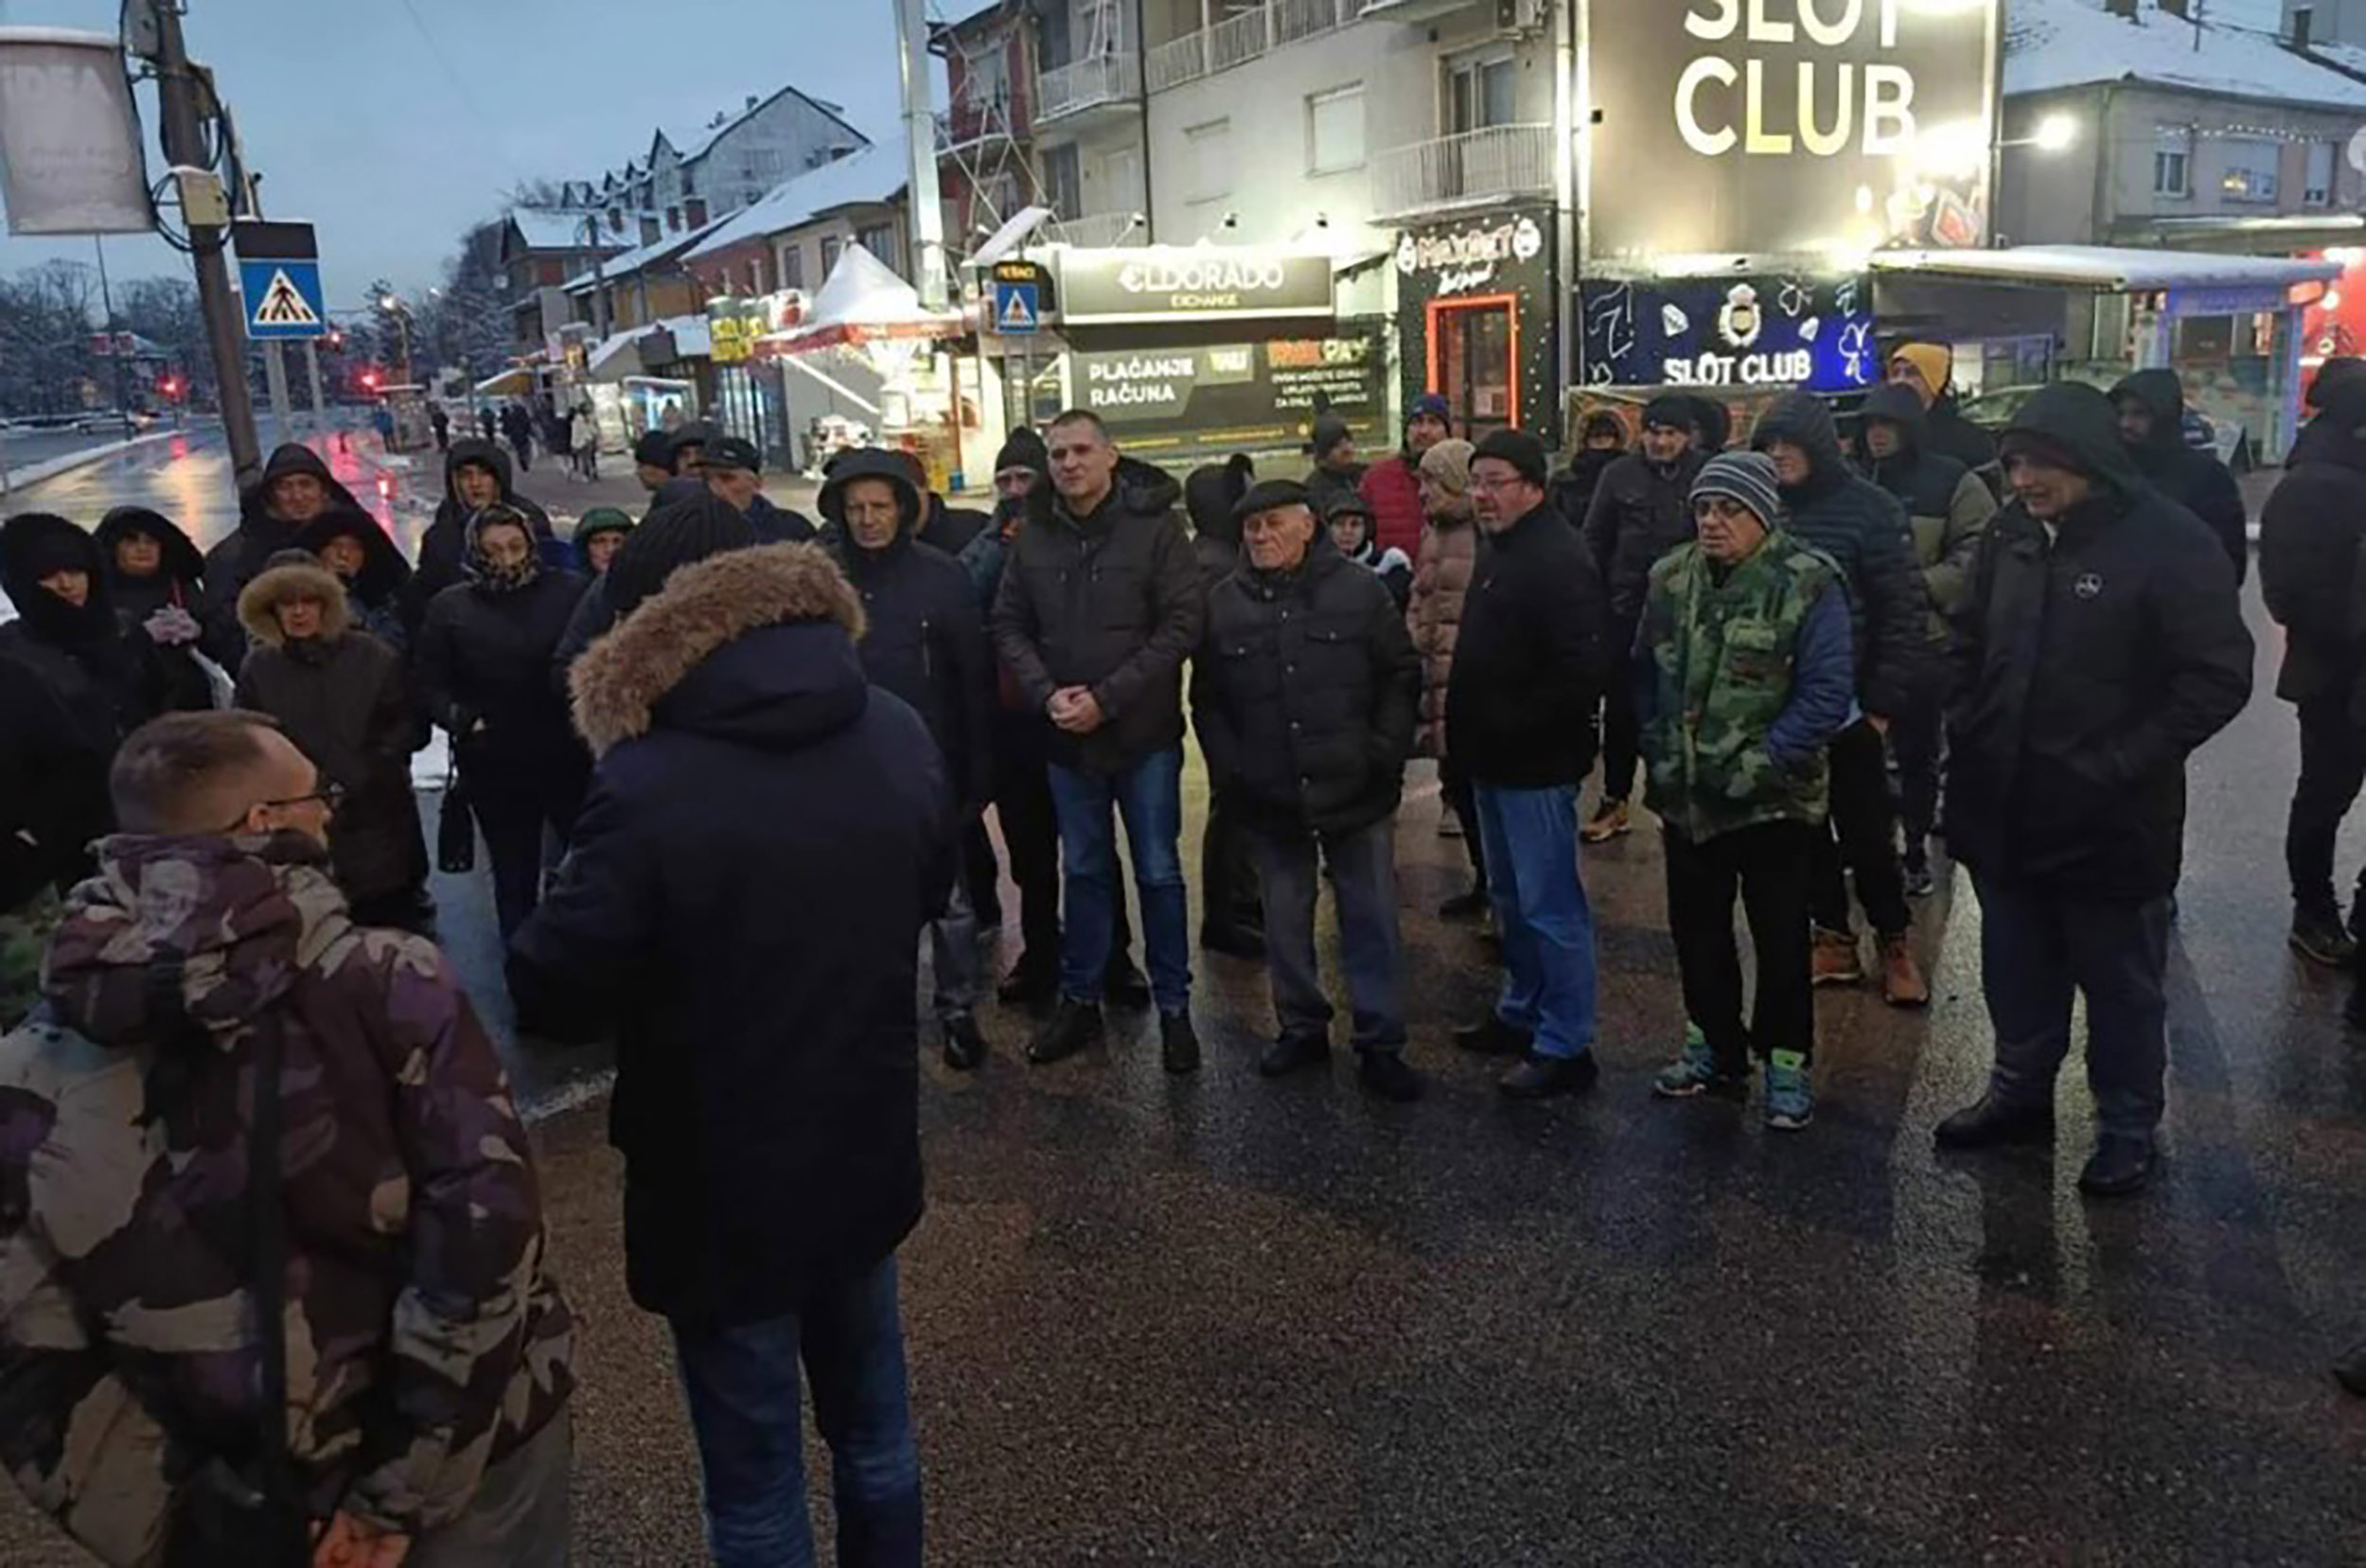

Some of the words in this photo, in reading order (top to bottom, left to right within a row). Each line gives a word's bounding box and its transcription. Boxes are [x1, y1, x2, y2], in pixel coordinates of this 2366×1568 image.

[1674, 56, 1916, 155] CLUB
[1664, 353, 1736, 385] SLOT
[1739, 348, 1811, 383] CLUB
